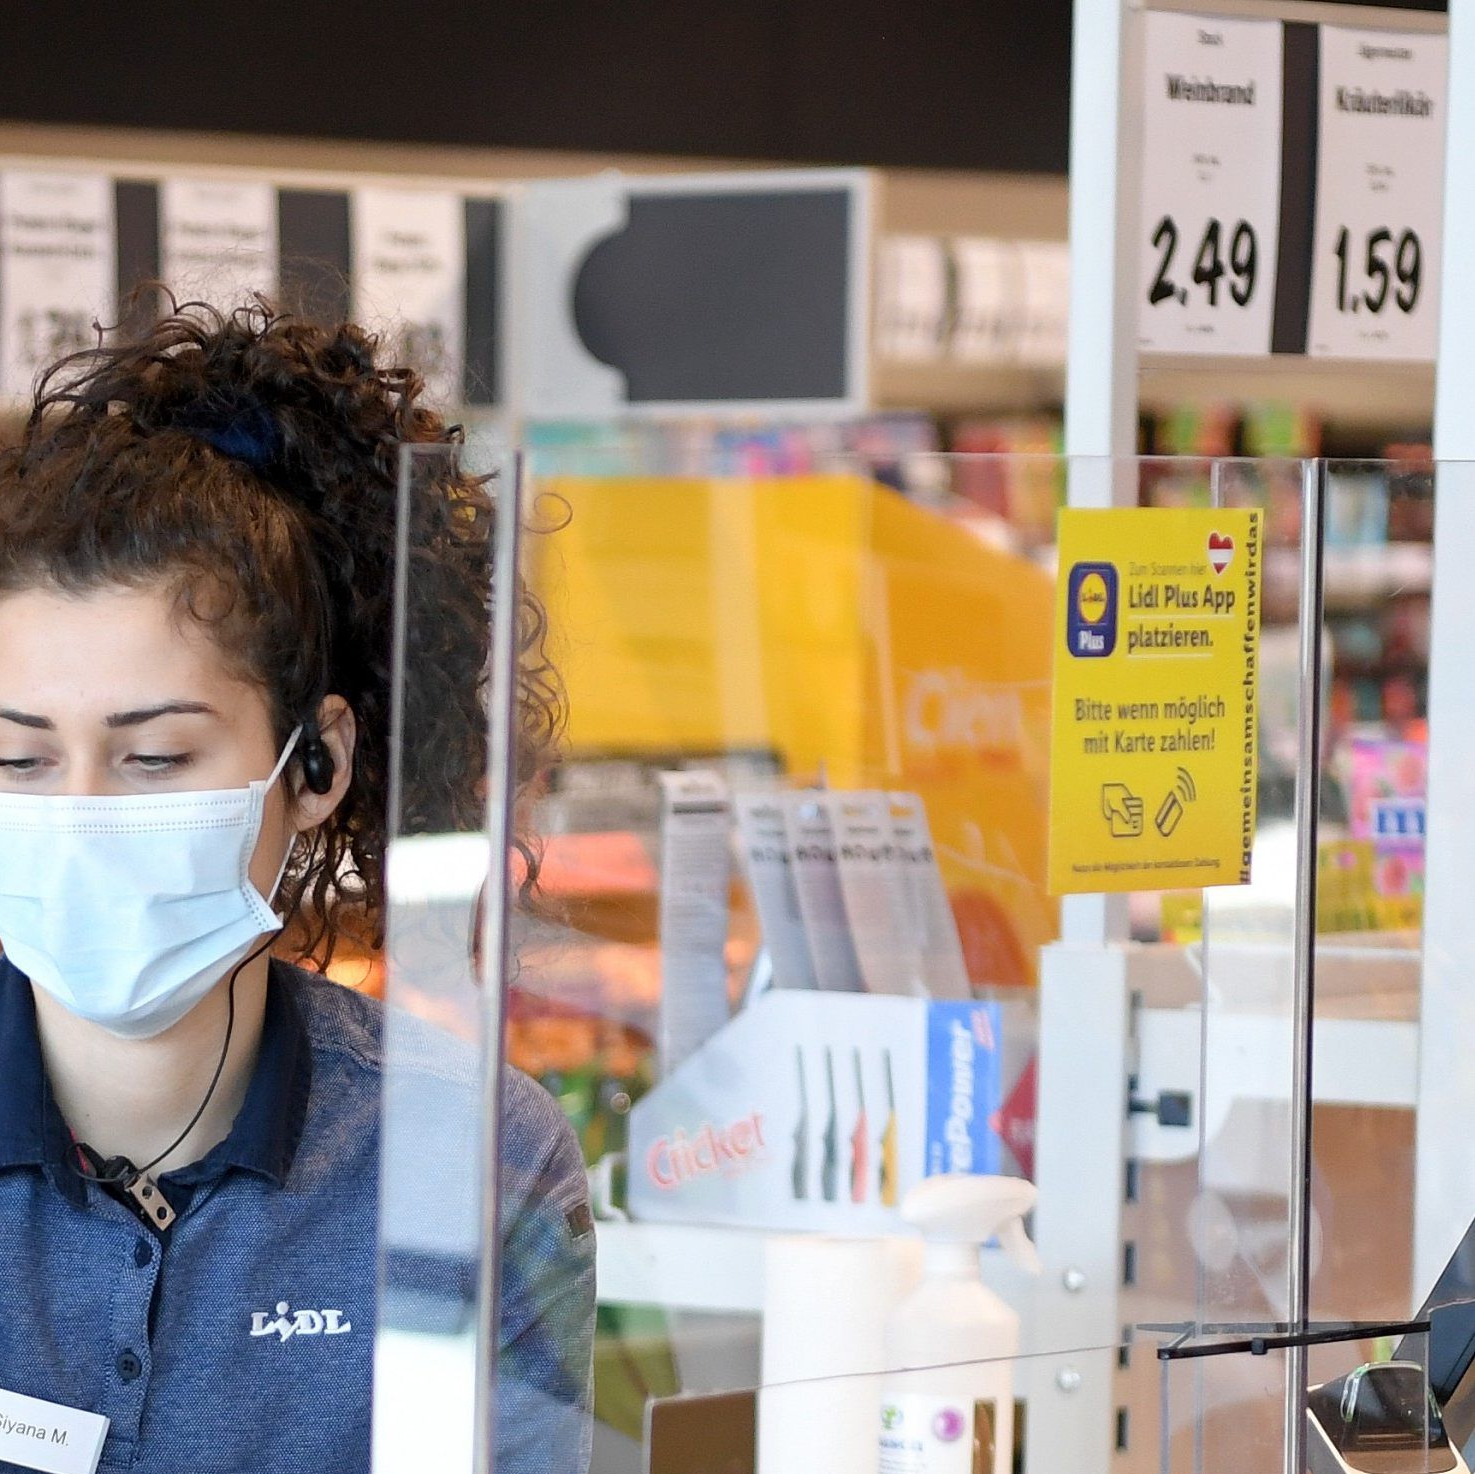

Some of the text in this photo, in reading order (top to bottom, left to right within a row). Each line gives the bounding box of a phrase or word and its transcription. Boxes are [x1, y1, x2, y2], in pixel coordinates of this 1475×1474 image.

[1166, 74, 1255, 106] Weinbrand
[1335, 84, 1434, 117] Kräuterlikör
[1147, 213, 1258, 307] 2.49
[1335, 223, 1422, 314] 1.59
[1129, 583, 1235, 614] Lidl Plus App
[1079, 630, 1105, 651] Plus
[1128, 623, 1214, 654] platzieren.
[1075, 694, 1225, 724] Bitte wenn möglich
[1240, 512, 1258, 884] #gemeinsamschaffenwirdas
[1084, 728, 1215, 753] mit Karte zahlen!
[647, 1112, 765, 1190] Cricket
[50, 1428, 69, 1447] M.
